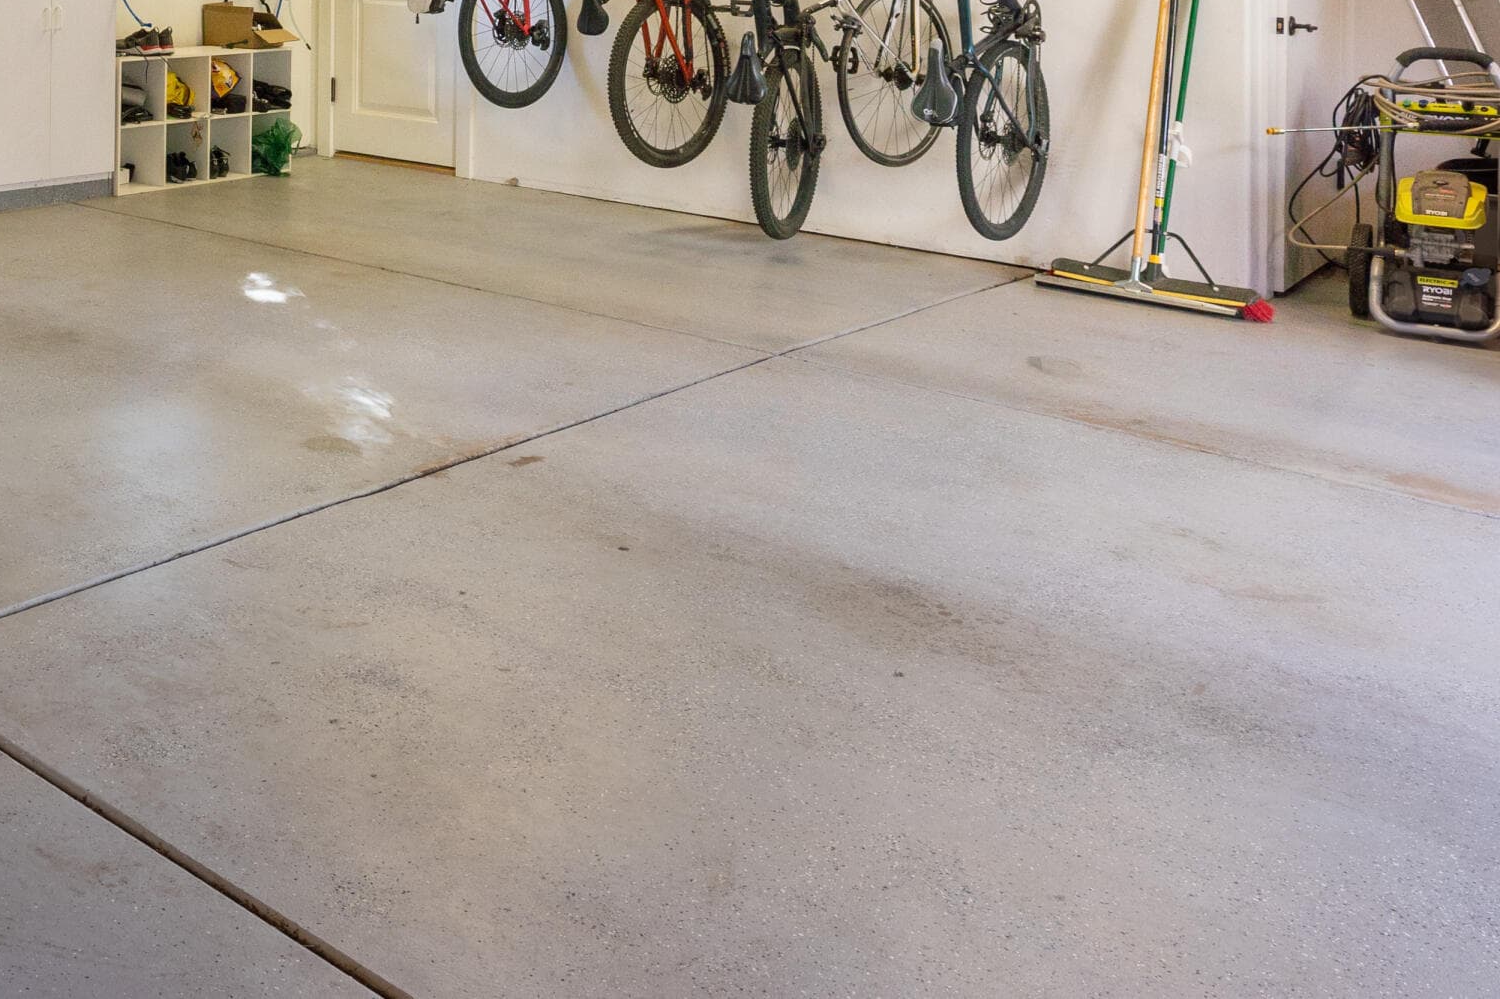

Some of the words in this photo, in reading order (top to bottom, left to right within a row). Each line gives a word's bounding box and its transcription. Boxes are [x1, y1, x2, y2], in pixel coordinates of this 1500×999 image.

[1425, 209, 1448, 217] RYOBI
[1419, 277, 1450, 285] ELECTRIC
[1422, 286, 1453, 296] RYOBI
